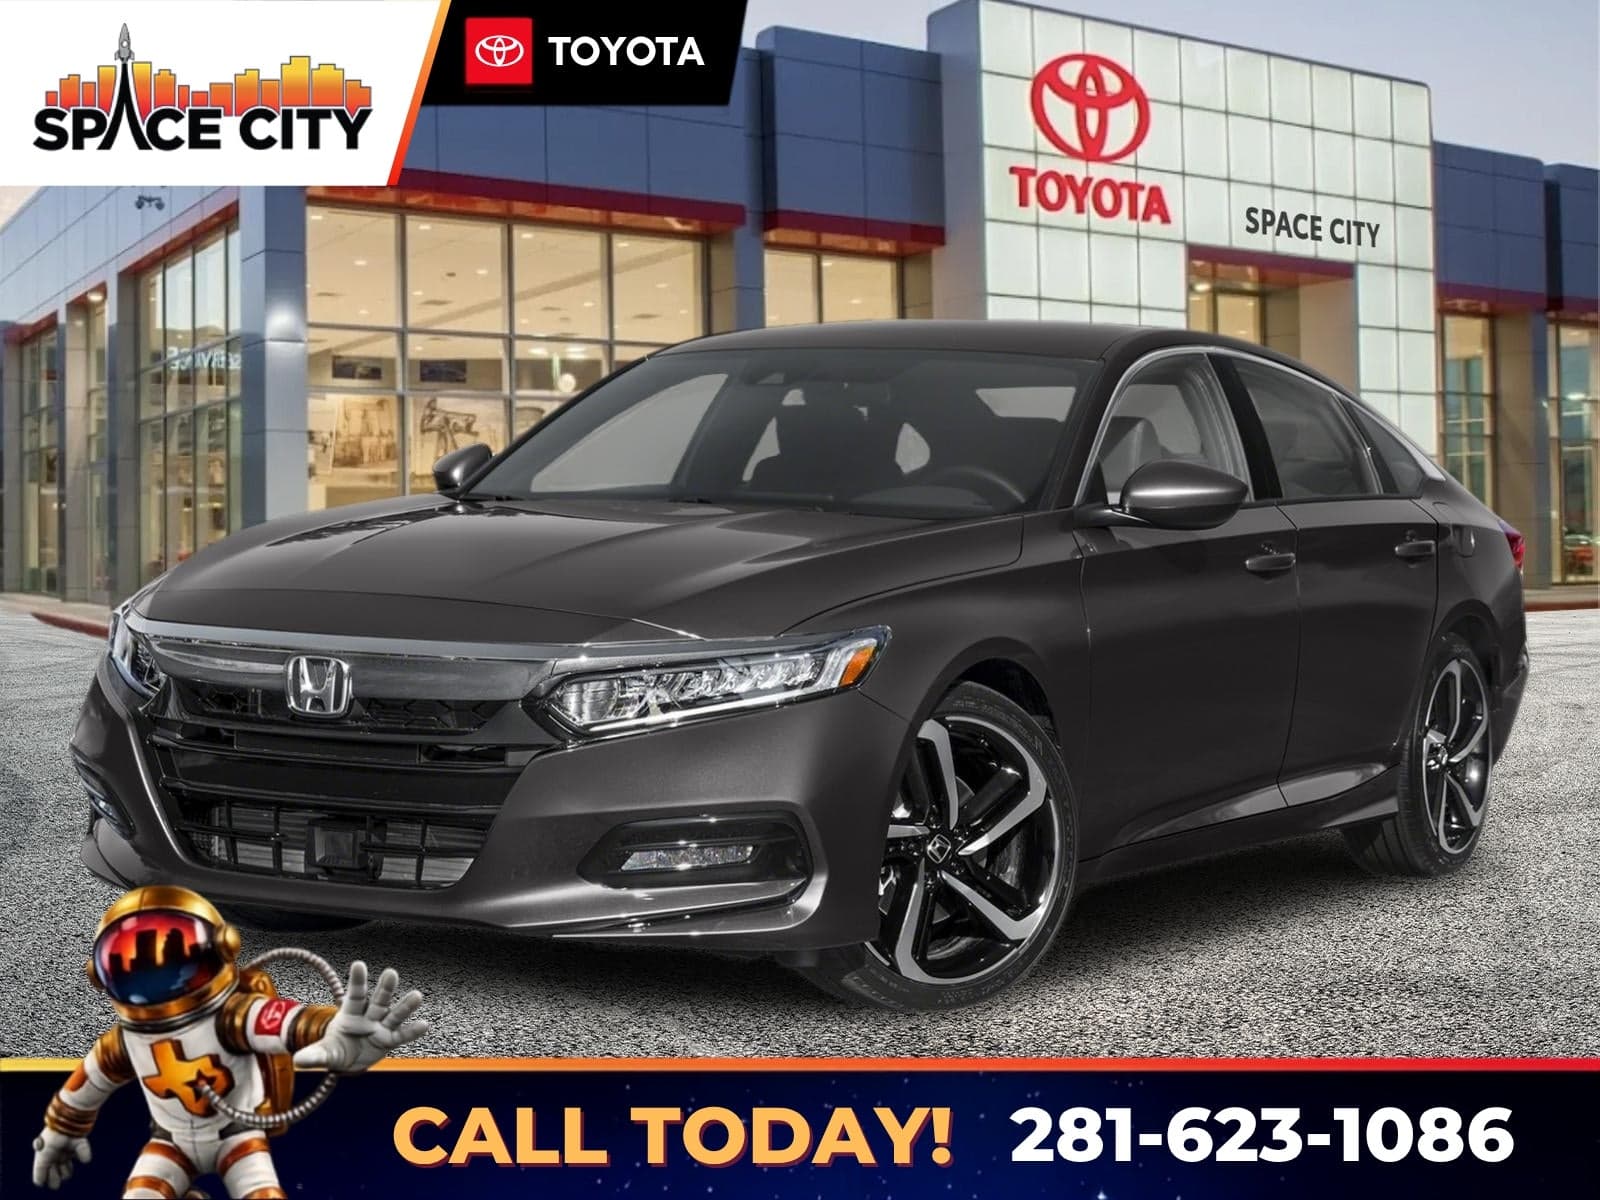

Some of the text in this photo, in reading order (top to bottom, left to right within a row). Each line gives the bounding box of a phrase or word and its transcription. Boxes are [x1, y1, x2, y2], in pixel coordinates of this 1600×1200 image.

[1009, 166, 1171, 224] TOYOTA
[1245, 206, 1381, 249] SPACE CITY
